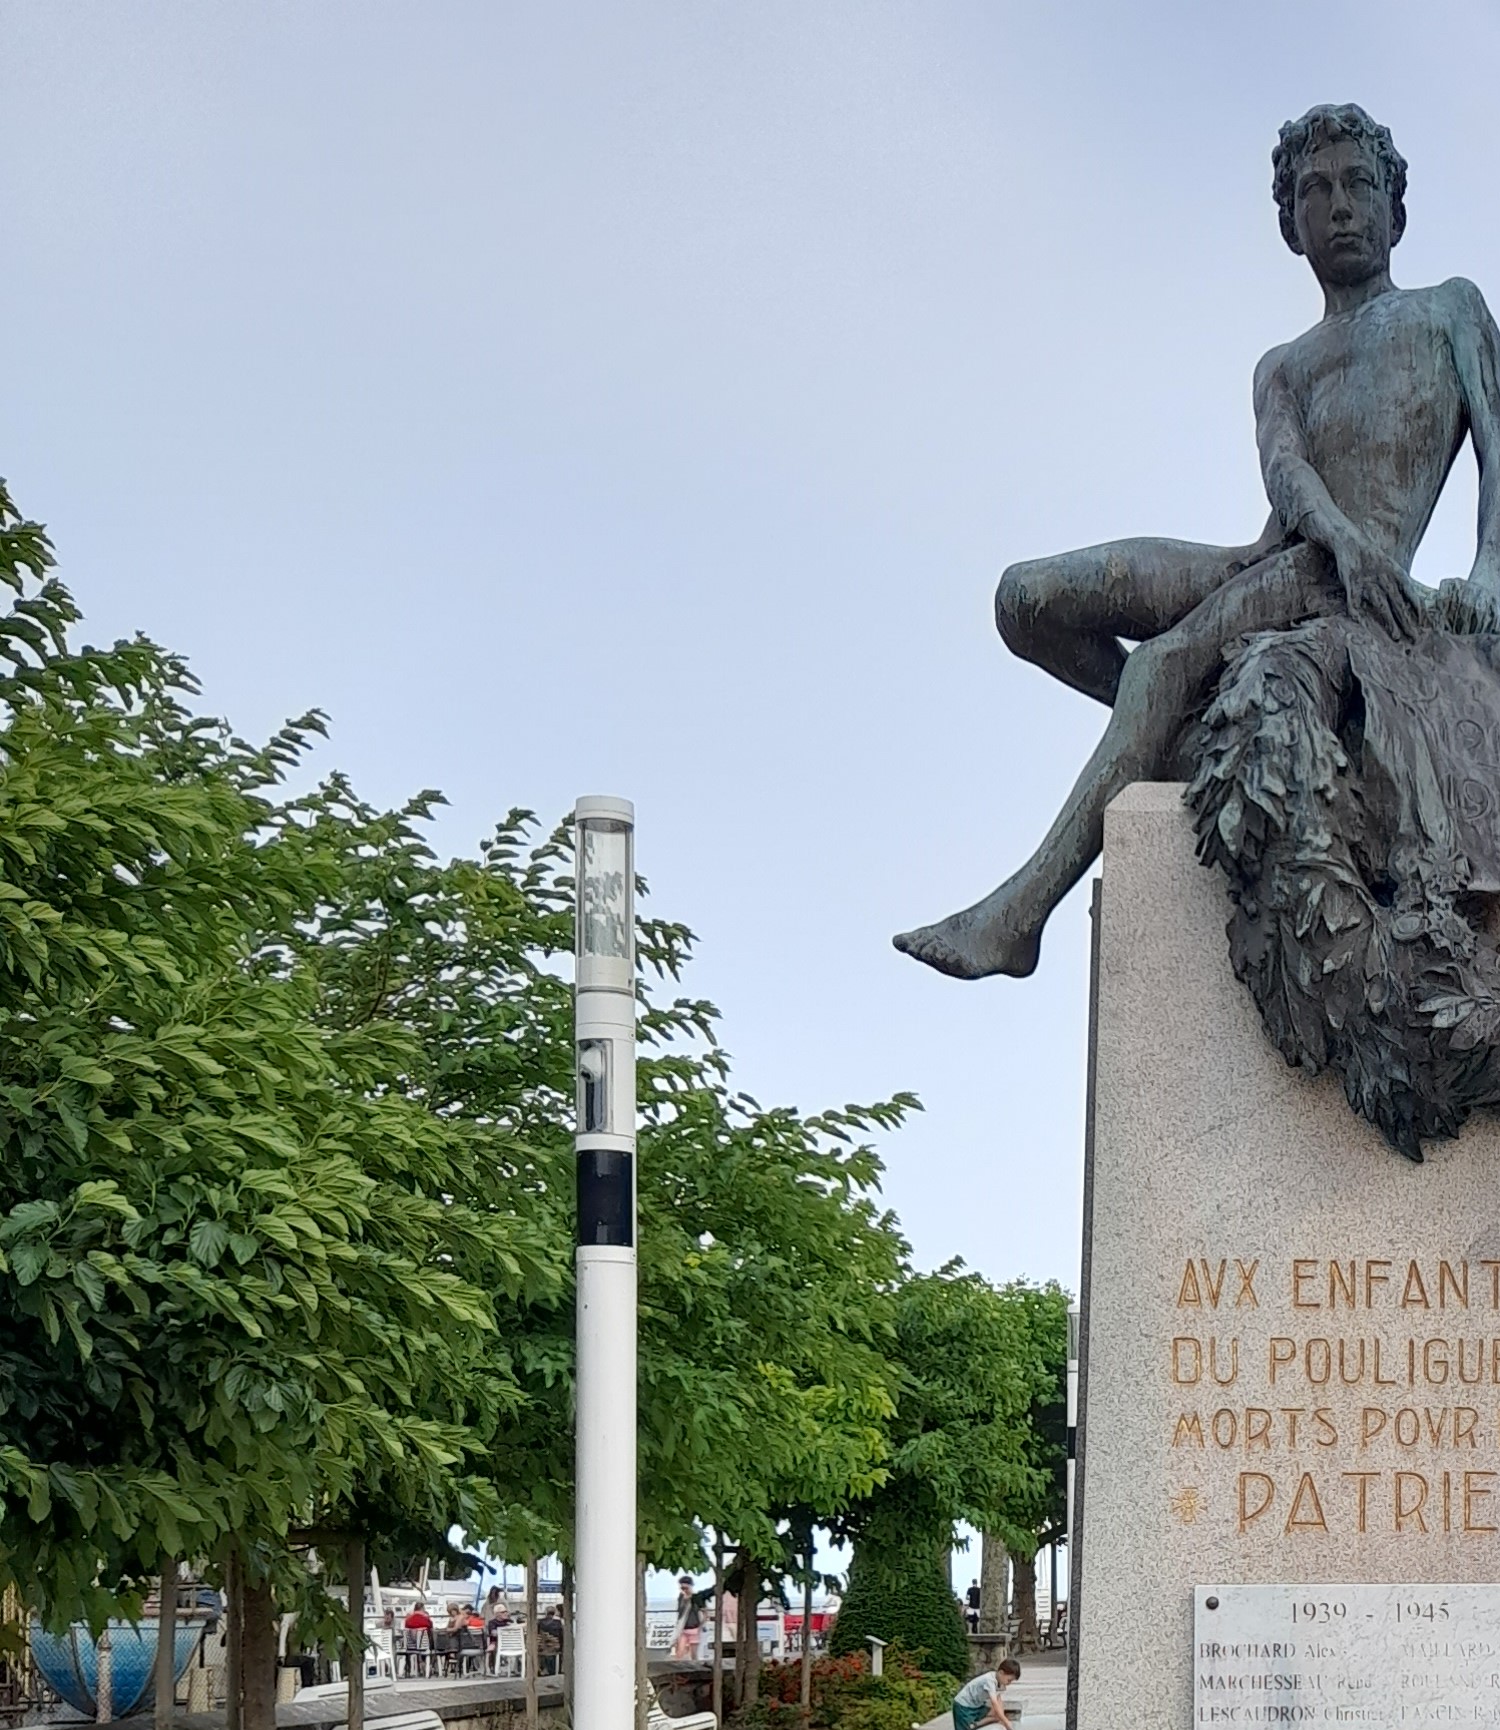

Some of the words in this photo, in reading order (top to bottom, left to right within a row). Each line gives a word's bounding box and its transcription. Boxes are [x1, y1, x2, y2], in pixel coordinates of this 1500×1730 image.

[1176, 1257, 1260, 1309] AVX
[1171, 1337, 1239, 1386] DU
[1171, 1408, 1338, 1449] MORTS
[1361, 1407, 1478, 1449] POVR
[1238, 1471, 1498, 1534] PATRIE
[1291, 1602, 1347, 1624] 1939
[1395, 1601, 1450, 1624] 1945
[1199, 1643, 1296, 1659] BROCHARD
[1199, 1706, 1316, 1722] LESCAUDRON
